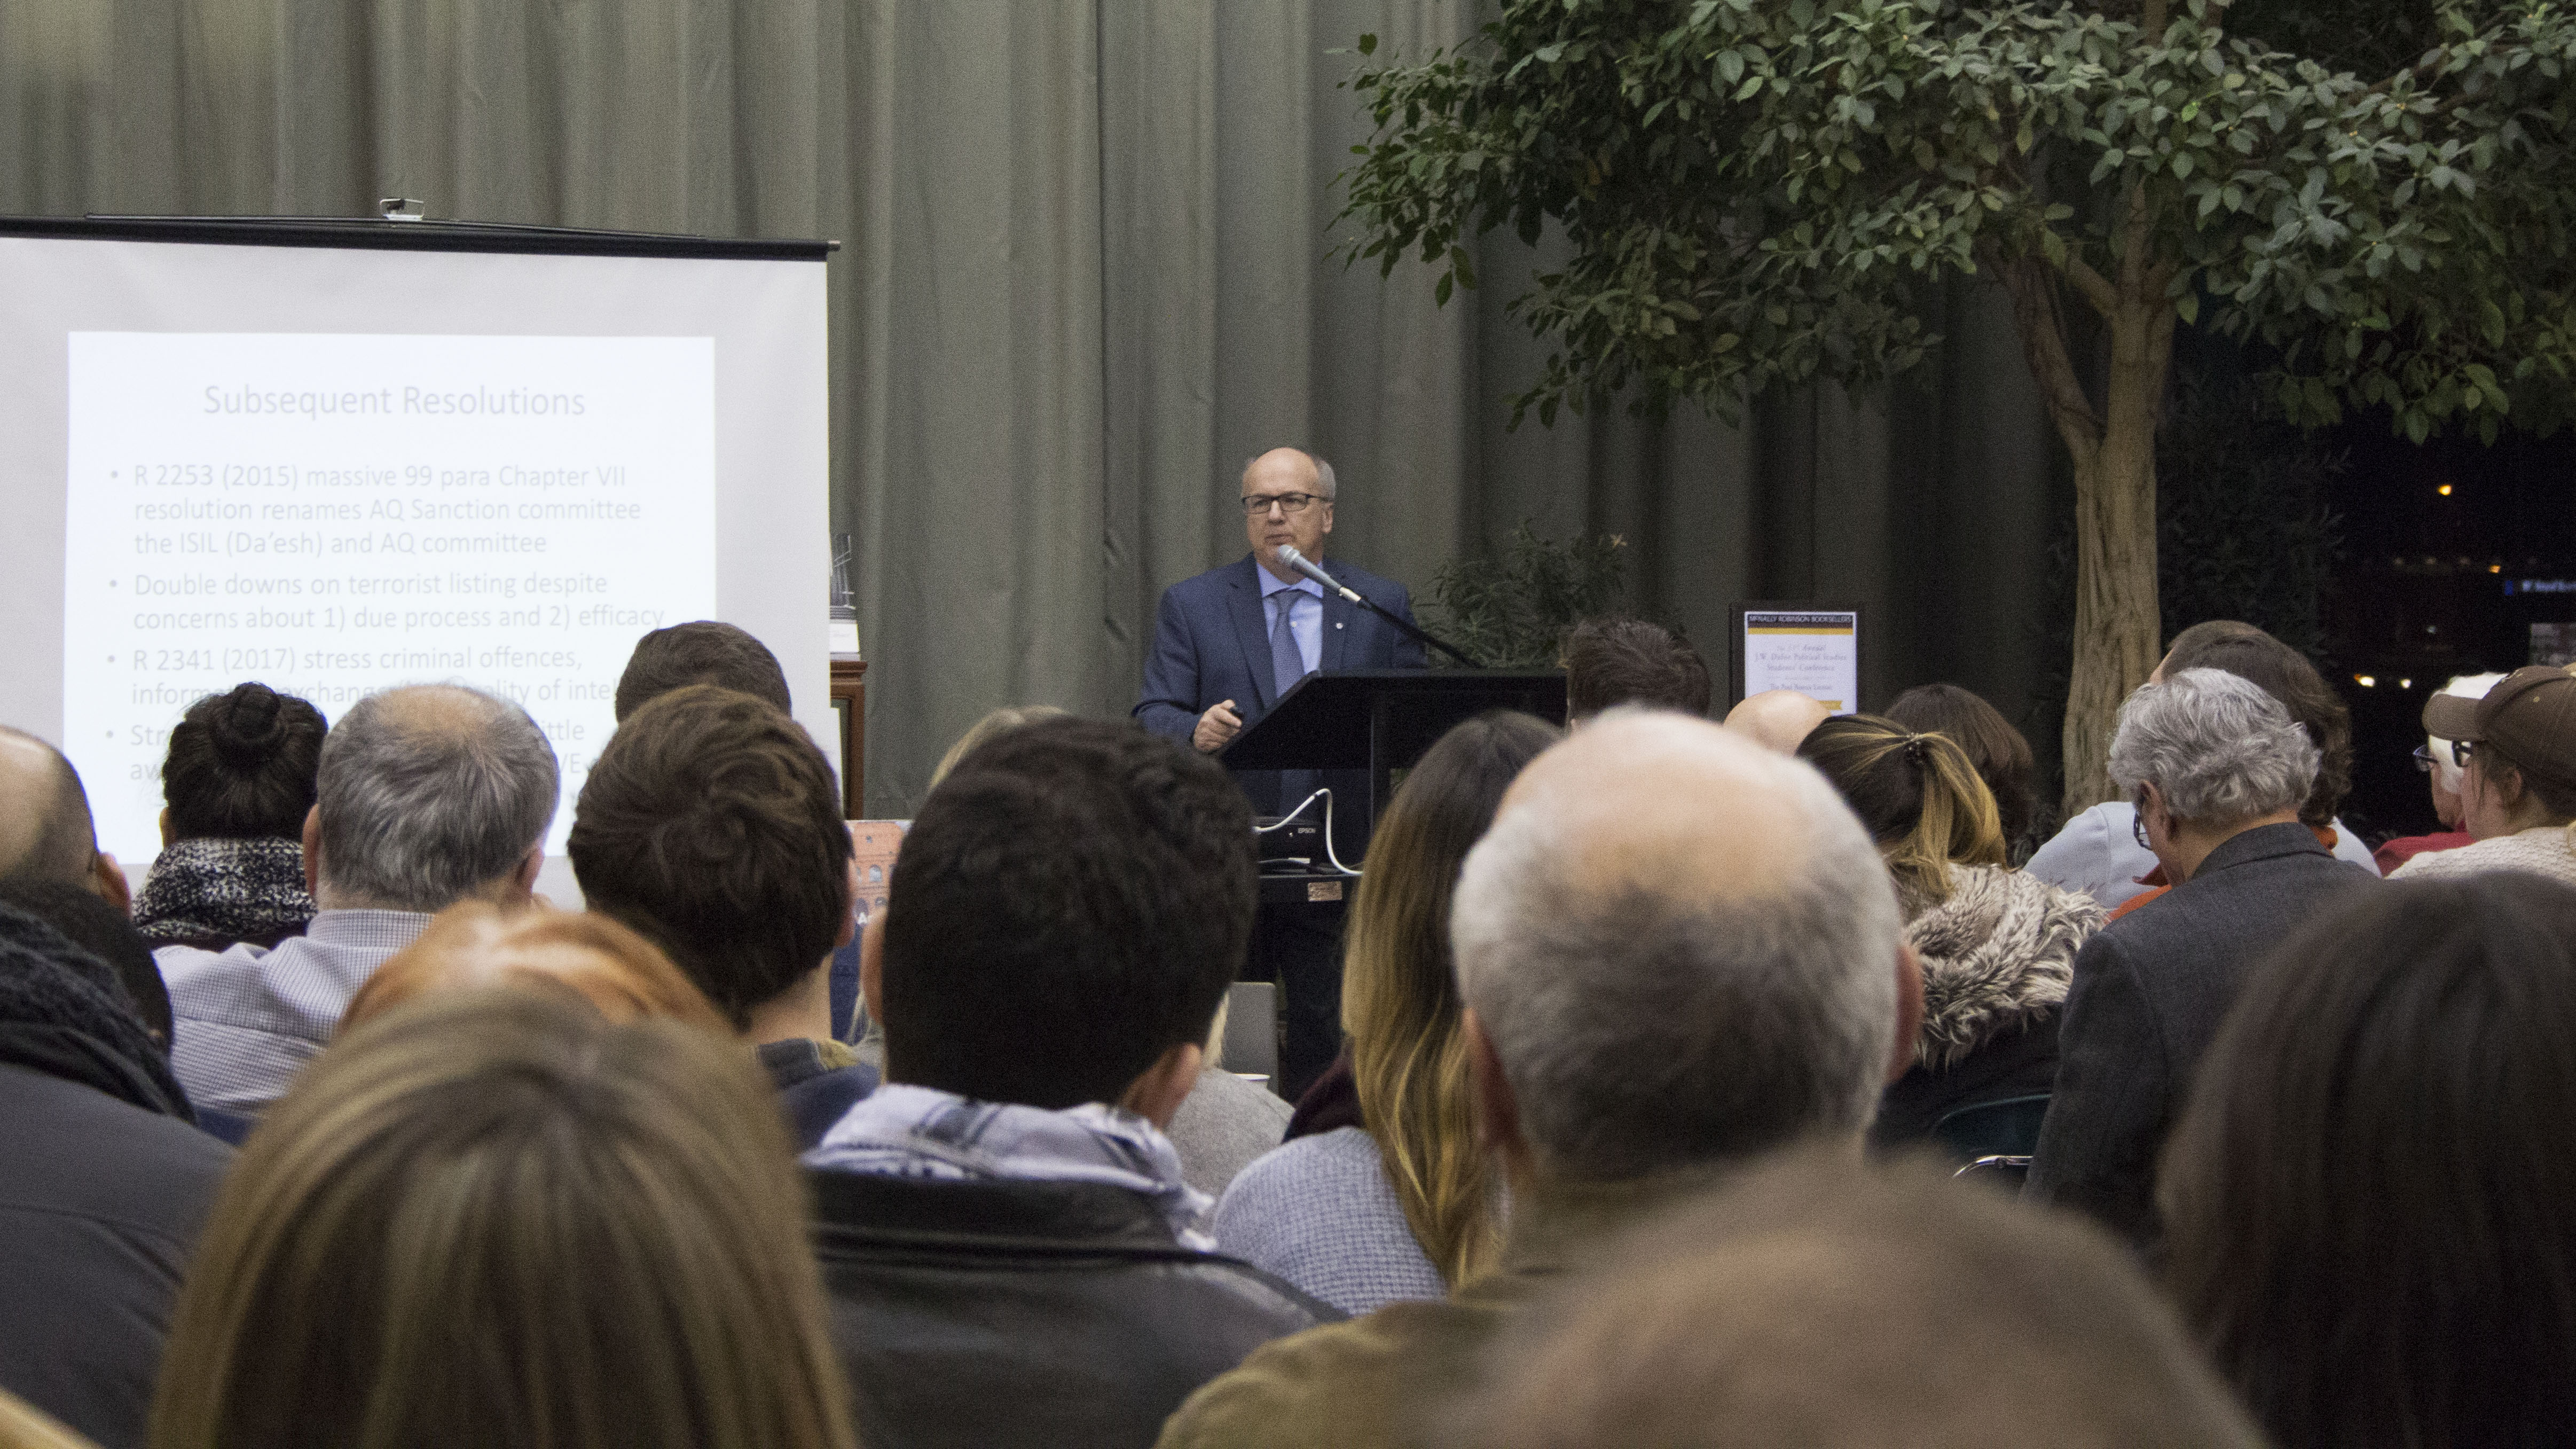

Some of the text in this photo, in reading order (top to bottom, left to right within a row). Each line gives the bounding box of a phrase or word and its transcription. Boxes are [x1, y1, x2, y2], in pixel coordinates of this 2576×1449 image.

[203, 383, 585, 421] Subsequent Resolutions
[135, 464, 625, 491] R 2253 (2015) massive 99 para Chapter VII
[135, 497, 641, 522] resolution renames AQ Sanction committee
[134, 532, 172, 554] the
[180, 531, 218, 554] ISIL
[331, 531, 373, 554] and
[380, 531, 416, 555] AQ
[422, 532, 547, 553] committee
[135, 571, 608, 599] Double downs on terrorist listing despite
[133, 604, 665, 632] concerns about 1) due process and 2) efficacy
[133, 645, 582, 675] R 2341 (2017) stress criminal offences,
[538, 678, 561, 701] of
[130, 724, 170, 746] Str
